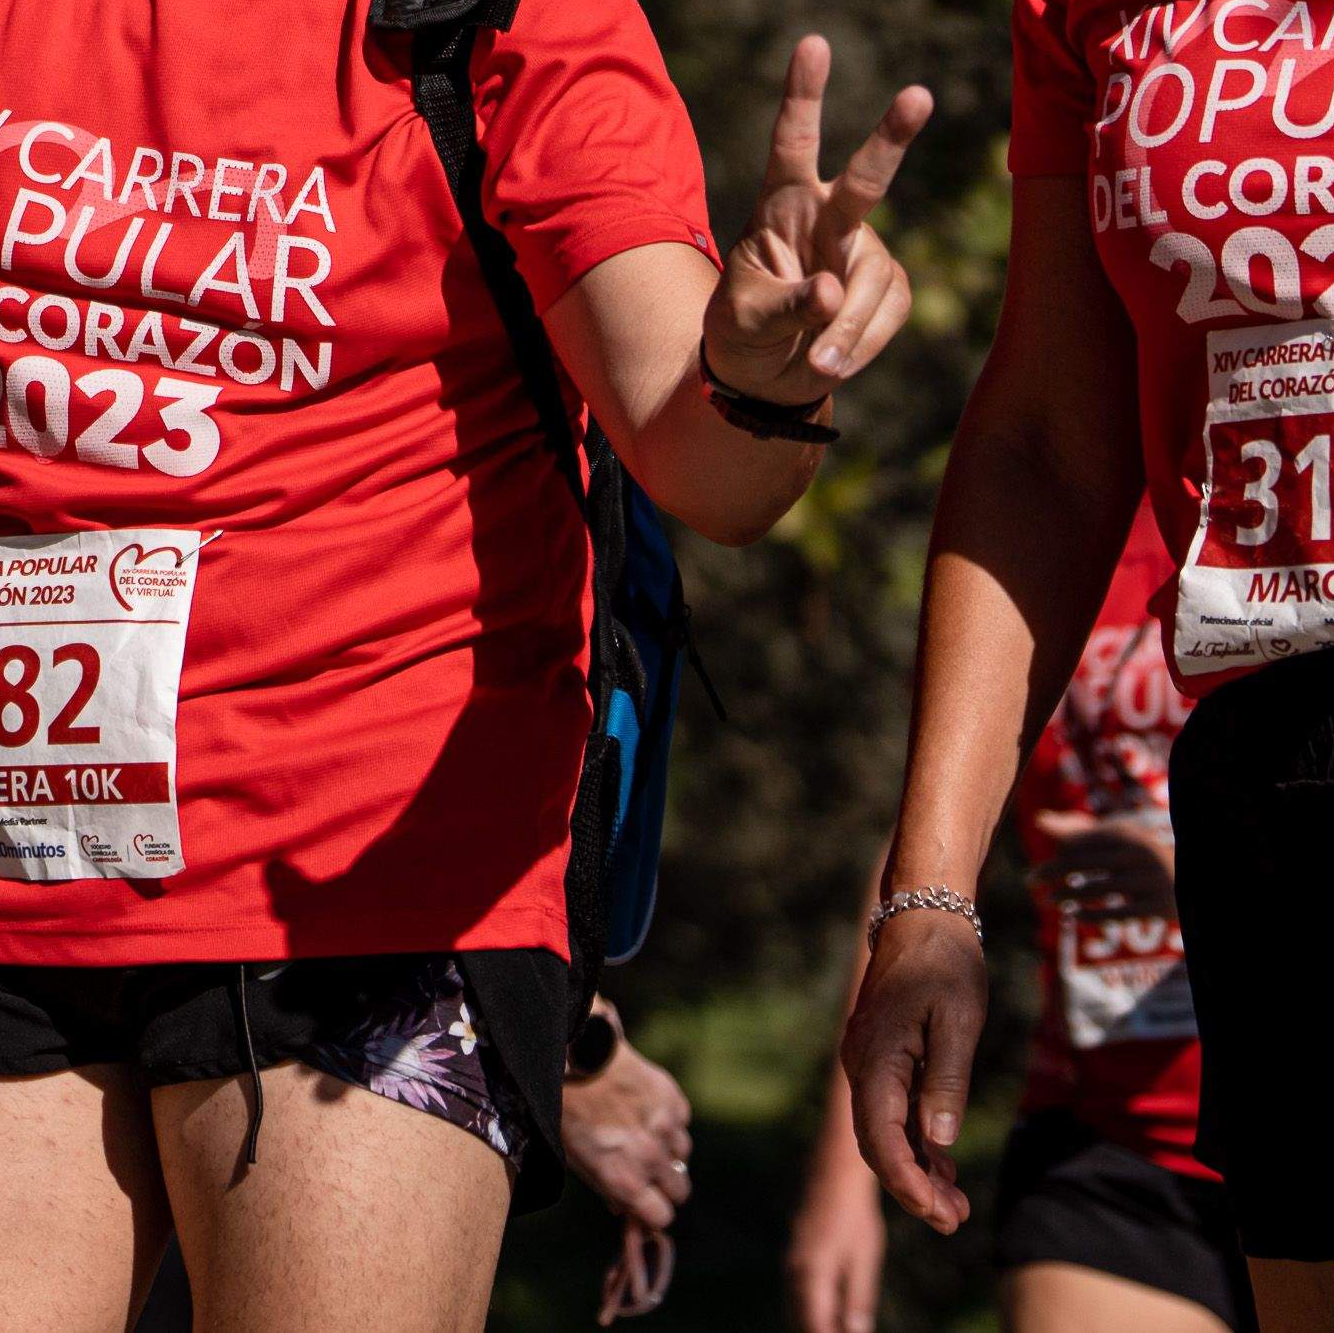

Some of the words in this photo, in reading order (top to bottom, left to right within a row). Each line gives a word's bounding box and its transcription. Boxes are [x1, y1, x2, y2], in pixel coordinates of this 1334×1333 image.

[18, 120, 337, 233] CARRERA
[1093, 166, 1168, 234] DEL
[1213, 351, 1240, 374] XIV
[1242, 342, 1325, 368] CARRERA
[1228, 381, 1257, 405] DEL
[7, 554, 99, 577] POPULAR
[119, 576, 135, 585] DEL
[137, 576, 187, 587] CORAZÓN
[125, 587, 135, 596] IV
[137, 587, 175, 597] VIRTUAL
[29, 584, 76, 605] 2023
[64, 768, 124, 801] 10K
[20, 817, 48, 826] Partner
